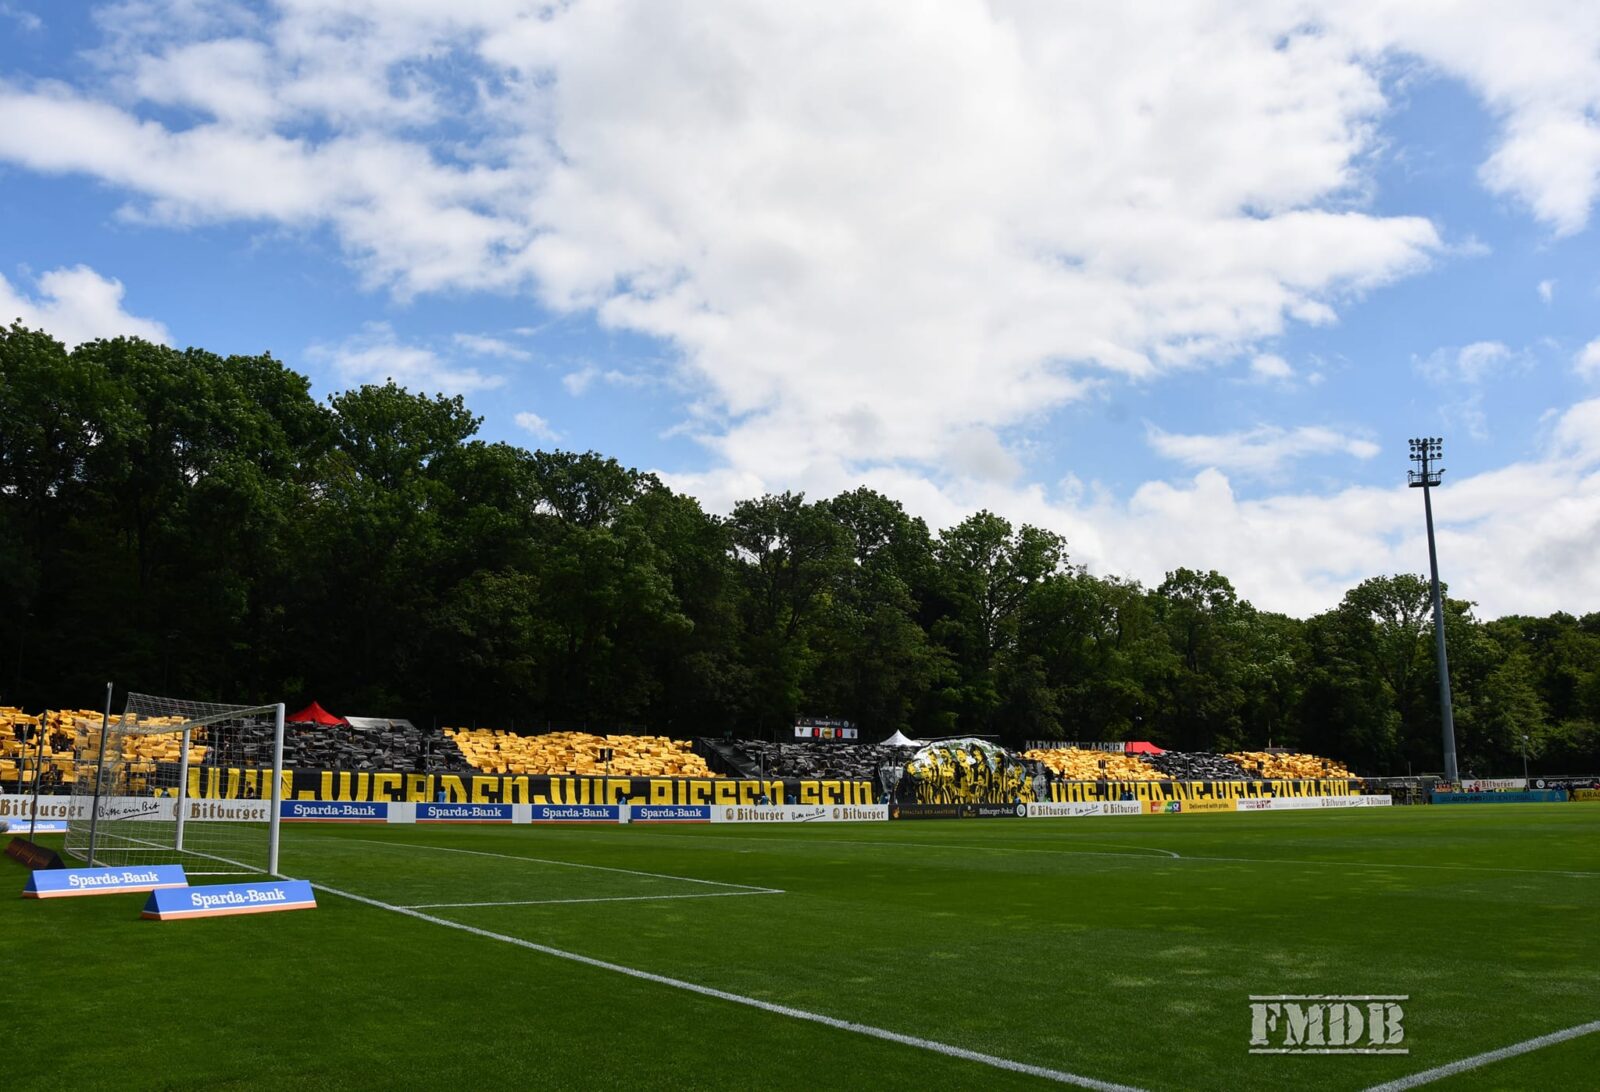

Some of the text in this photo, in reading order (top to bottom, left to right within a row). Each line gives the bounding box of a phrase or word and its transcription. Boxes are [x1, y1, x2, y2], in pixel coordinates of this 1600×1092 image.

[1090, 741, 1125, 752] AACHEN
[98, 806, 121, 817] Bitte
[142, 801, 160, 811] Bit
[190, 802, 266, 820] Bitburger
[294, 804, 376, 817] Sparda-Bank
[428, 806, 502, 818] Sparda-Bank
[542, 808, 609, 818] Sparda-Bank
[641, 808, 703, 818] Sparda-Bank
[737, 809, 784, 821] Bitburger
[843, 808, 889, 820] Bitburger
[1038, 805, 1070, 816] Bitburger
[1110, 803, 1139, 813] Bitburger
[70, 871, 160, 889] Sparda-Bank
[191, 887, 286, 908] Sparda-Bank
